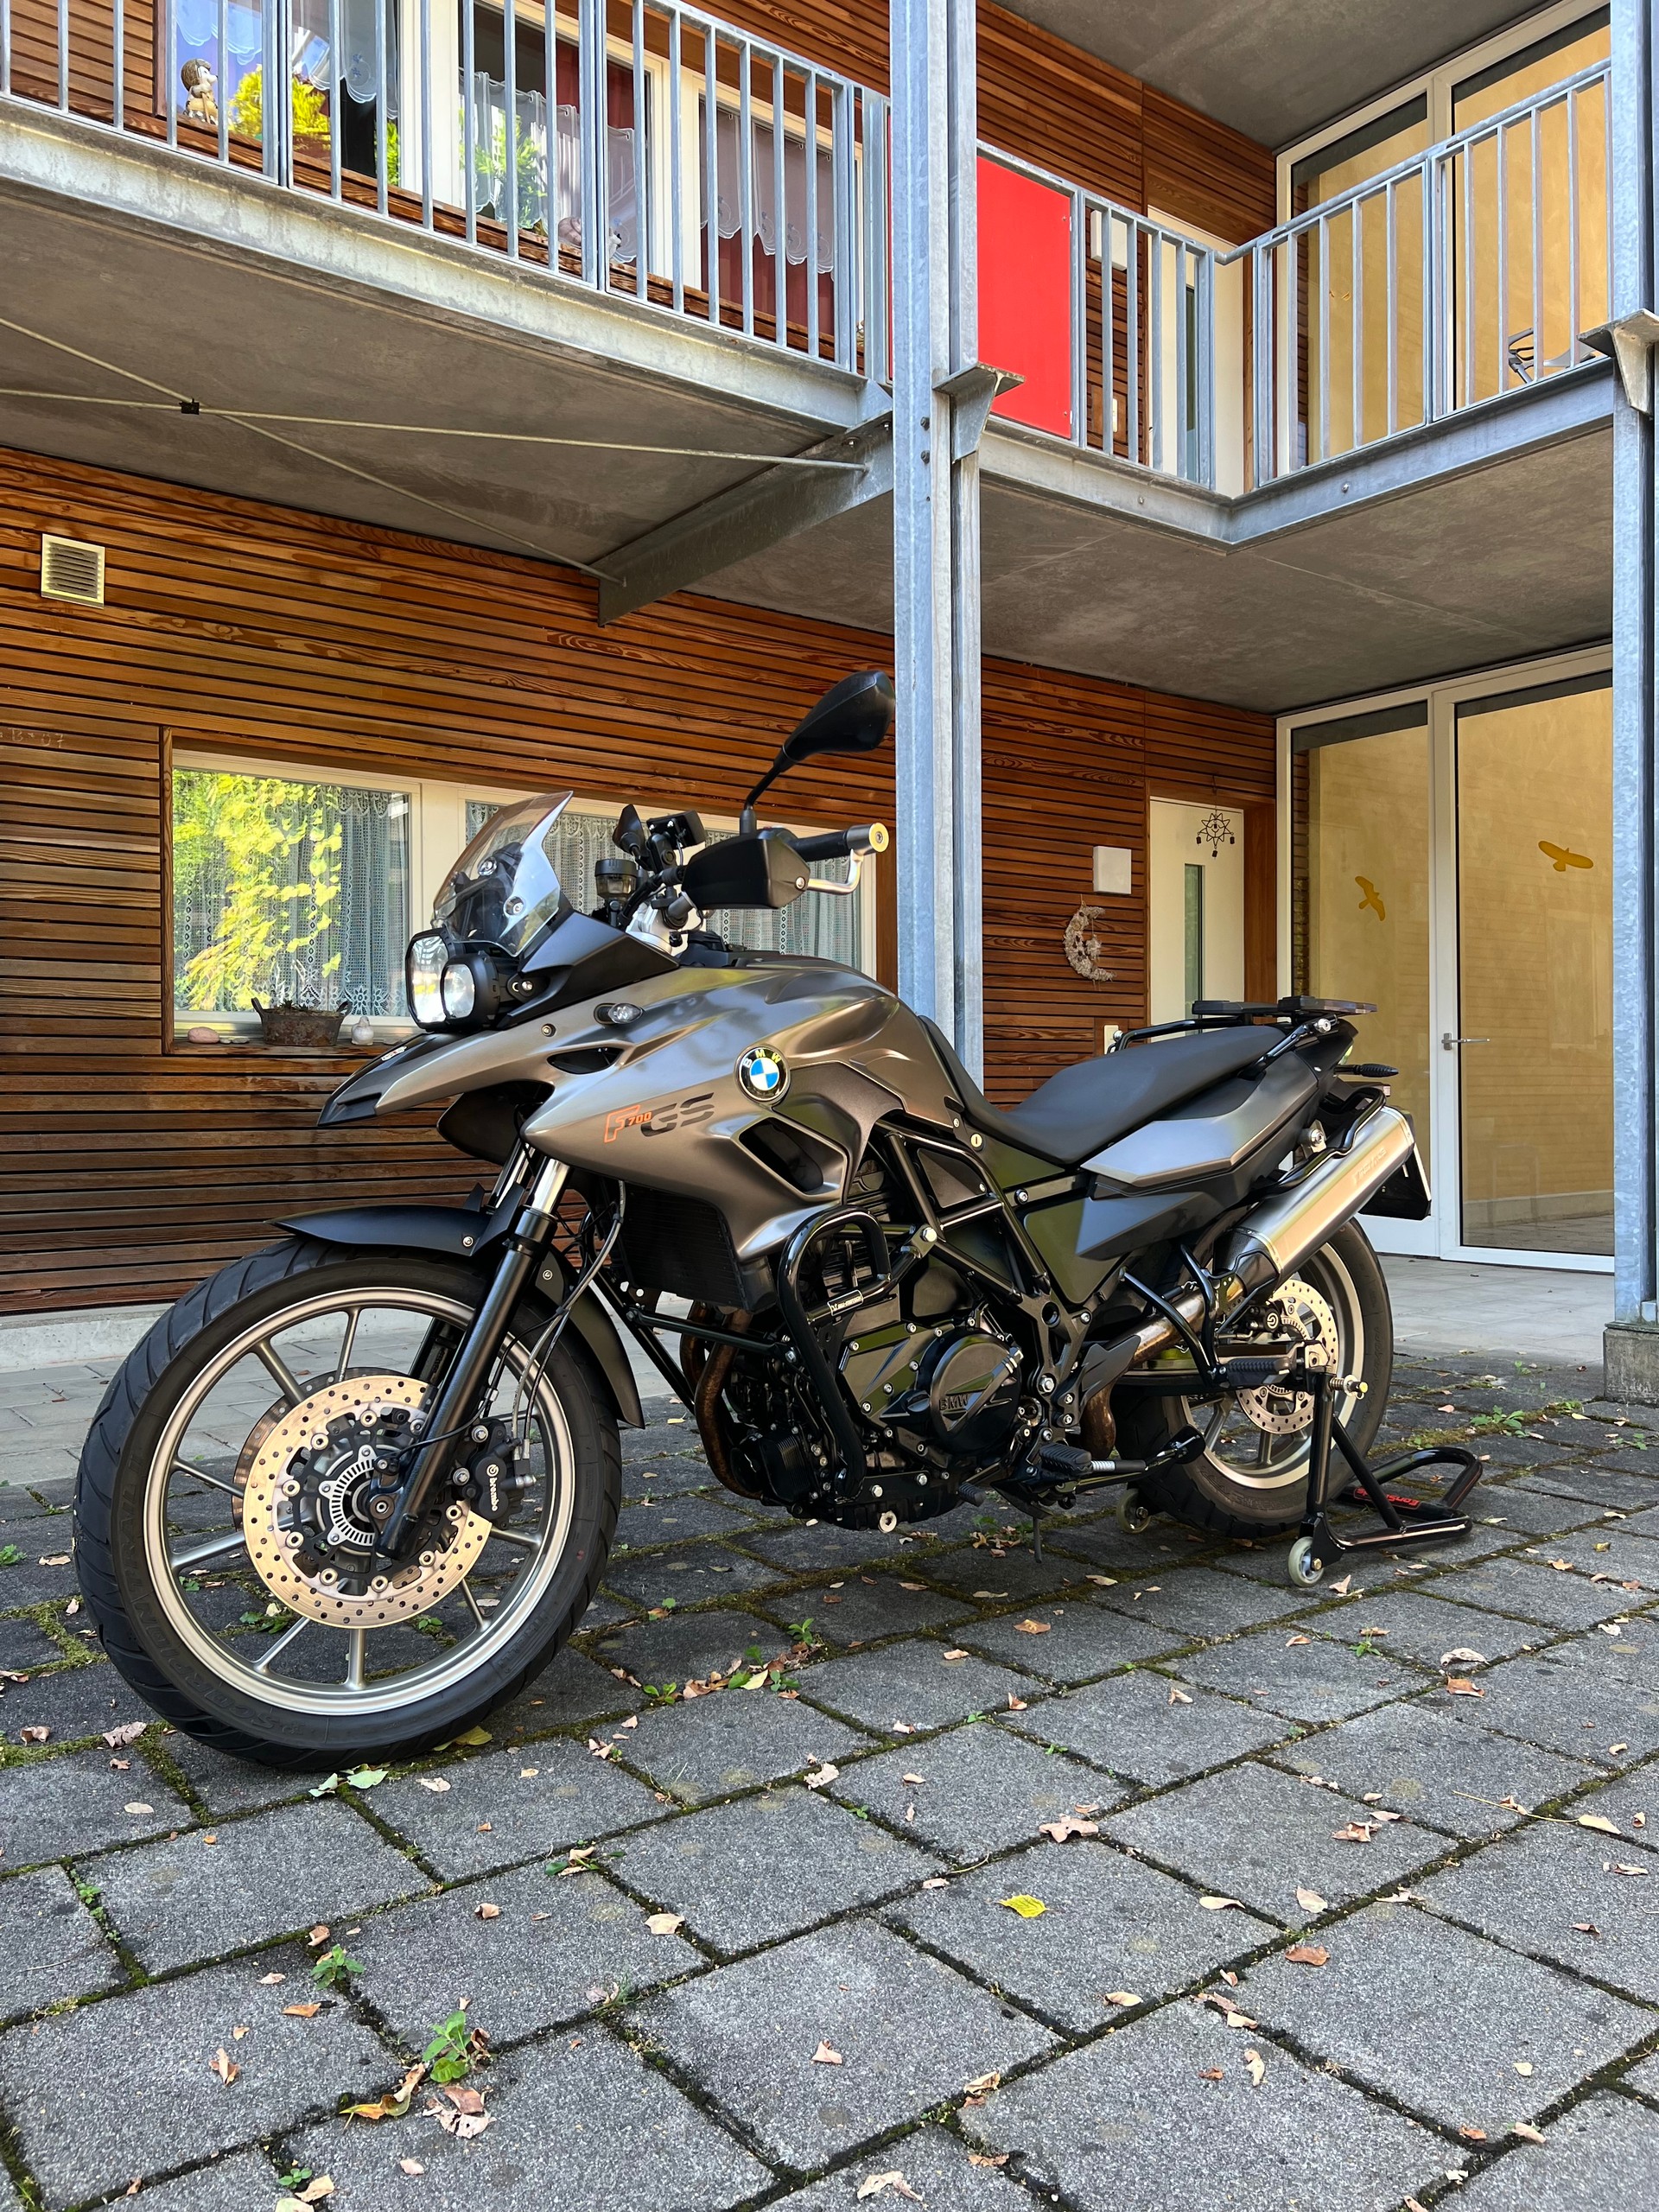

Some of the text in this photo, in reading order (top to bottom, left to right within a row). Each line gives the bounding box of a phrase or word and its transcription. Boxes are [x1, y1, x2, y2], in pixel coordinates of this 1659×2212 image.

[743, 1049, 782, 1069] BMW
[627, 1111, 652, 1126] 700
[640, 1092, 715, 1137] GS
[938, 1393, 969, 1411] BMW
[489, 1477, 499, 1512] brembo
